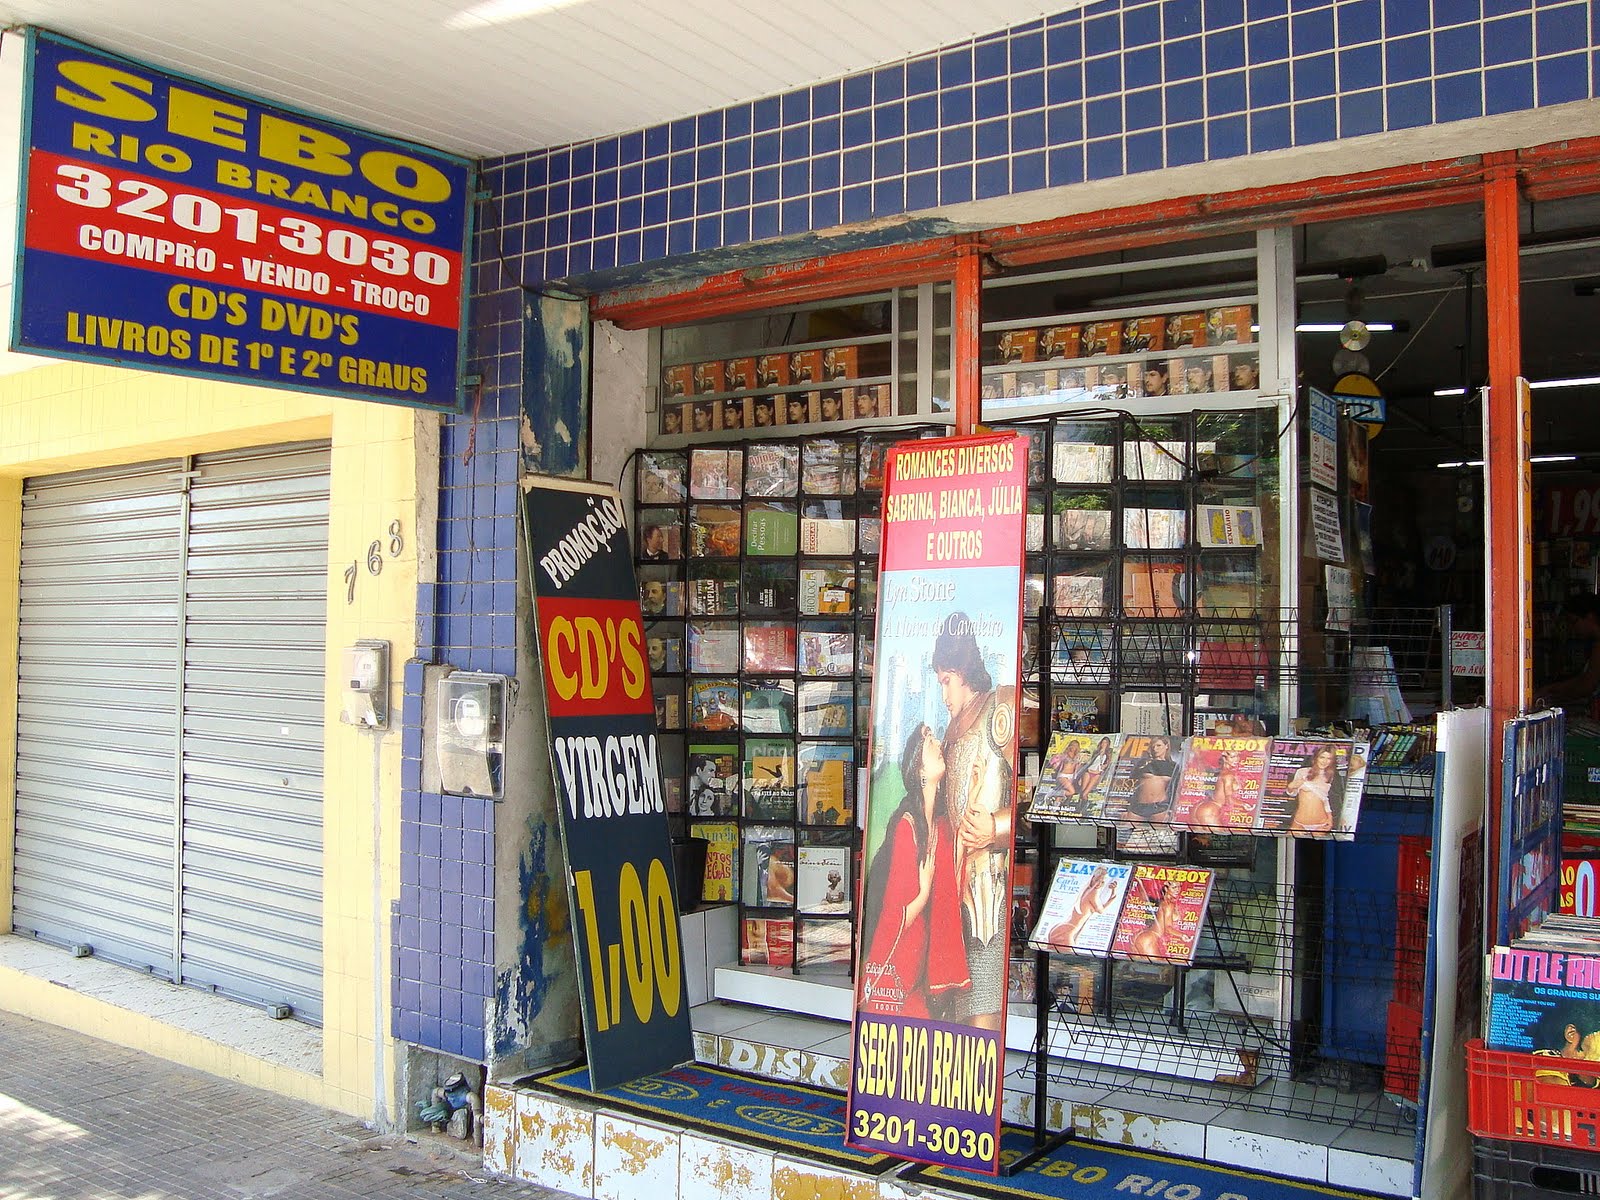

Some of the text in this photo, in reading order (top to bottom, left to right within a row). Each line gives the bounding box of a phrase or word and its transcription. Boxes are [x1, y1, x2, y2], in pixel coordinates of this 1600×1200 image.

[55, 59, 452, 203] SEBO
[72, 121, 437, 235] RIO BRANCO
[55, 163, 451, 286] 3201-3030
[78, 223, 217, 273] COMPRO
[241, 256, 330, 296] VENDO
[350, 278, 431, 317] TROCO
[167, 283, 360, 346] CD'S DVD'S
[66, 311, 428, 395] LIVROS DE 1º E 2º GRAUS
[896, 442, 1014, 481] ROMANCES DIVERSOS
[886, 479, 1022, 525] SABRINA, BIANCA, JÚLIA
[539, 496, 623, 590] PROMOÇÃO
[758, 517, 767, 551] Pessoas
[926, 529, 983, 561] E OUTROS
[885, 575, 956, 610] Lyn Stone
[929, 612, 946, 638] do
[948, 612, 1003, 638] Cavaleiro
[547, 614, 646, 701] CD'S
[1191, 737, 1270, 752] PLAYBOY
[1229, 815, 1254, 824] PATO
[1135, 866, 1210, 884] PLAYBOY
[574, 857, 681, 1033] 1,00
[1167, 945, 1189, 955] PATO
[1534, 986, 1546, 995] OS
[1547, 989, 1588, 1000] GRANDES
[729, 1041, 839, 1088] DISK
[857, 1019, 899, 1099] SEBO
[900, 1025, 928, 1105] RIO
[930, 1029, 998, 1117] BRANCO
[853, 1109, 995, 1162] 3201-3030
[1115, 1174, 1201, 1200] RIO
